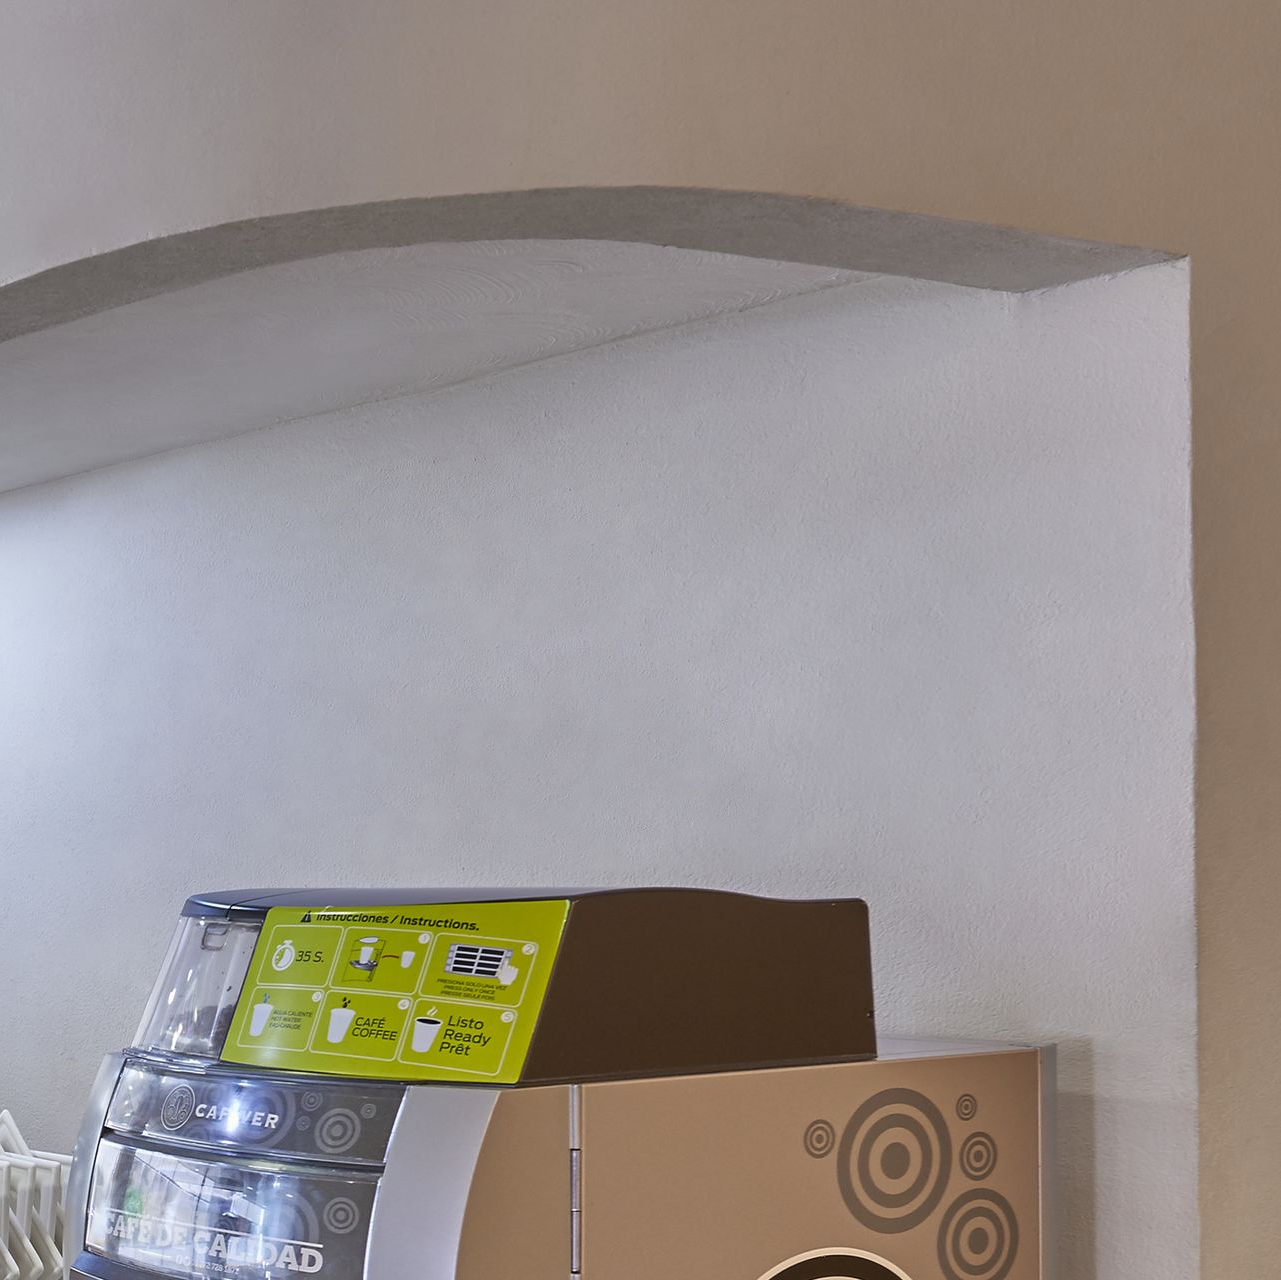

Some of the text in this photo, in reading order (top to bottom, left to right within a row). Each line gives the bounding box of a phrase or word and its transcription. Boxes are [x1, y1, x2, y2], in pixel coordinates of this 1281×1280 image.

[399, 915, 480, 931] Instructions.
[295, 950, 313, 962] 35
[355, 1016, 387, 1029] CAFÉ
[447, 1015, 484, 1030] Listo
[351, 1027, 398, 1041] COFFEE
[443, 1029, 492, 1047] Ready
[438, 1041, 471, 1056] Prêt
